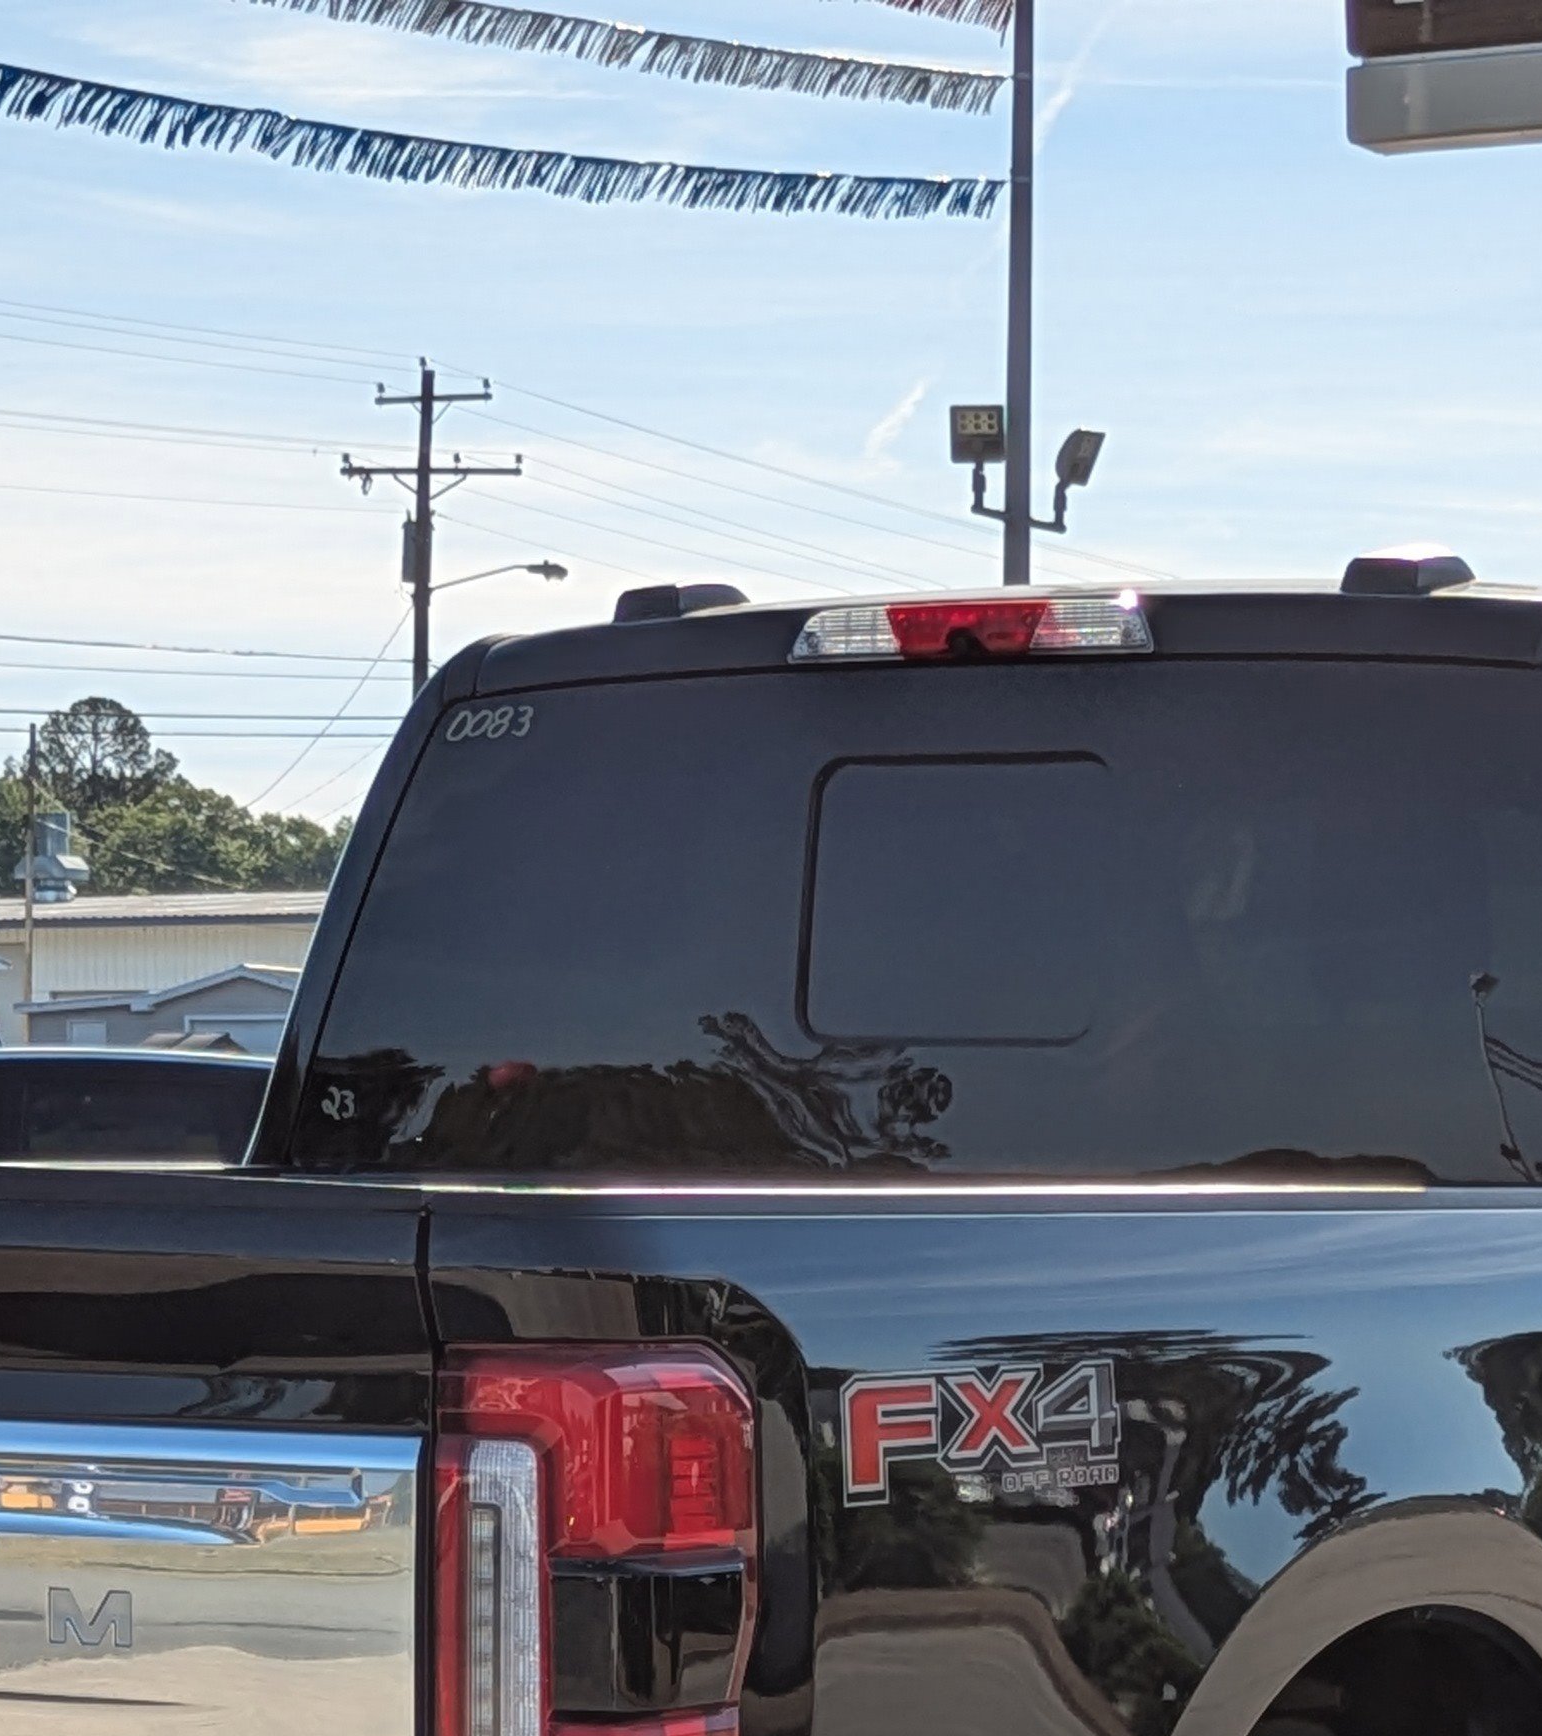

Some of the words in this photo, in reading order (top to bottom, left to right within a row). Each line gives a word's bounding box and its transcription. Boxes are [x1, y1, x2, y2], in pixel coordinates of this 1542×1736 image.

[446, 705, 534, 742] 0083
[320, 1086, 355, 1121] 23
[839, 1358, 1121, 1508] FX4
[1001, 1471, 1051, 1493] OFF
[1057, 1463, 1120, 1487] ROAD
